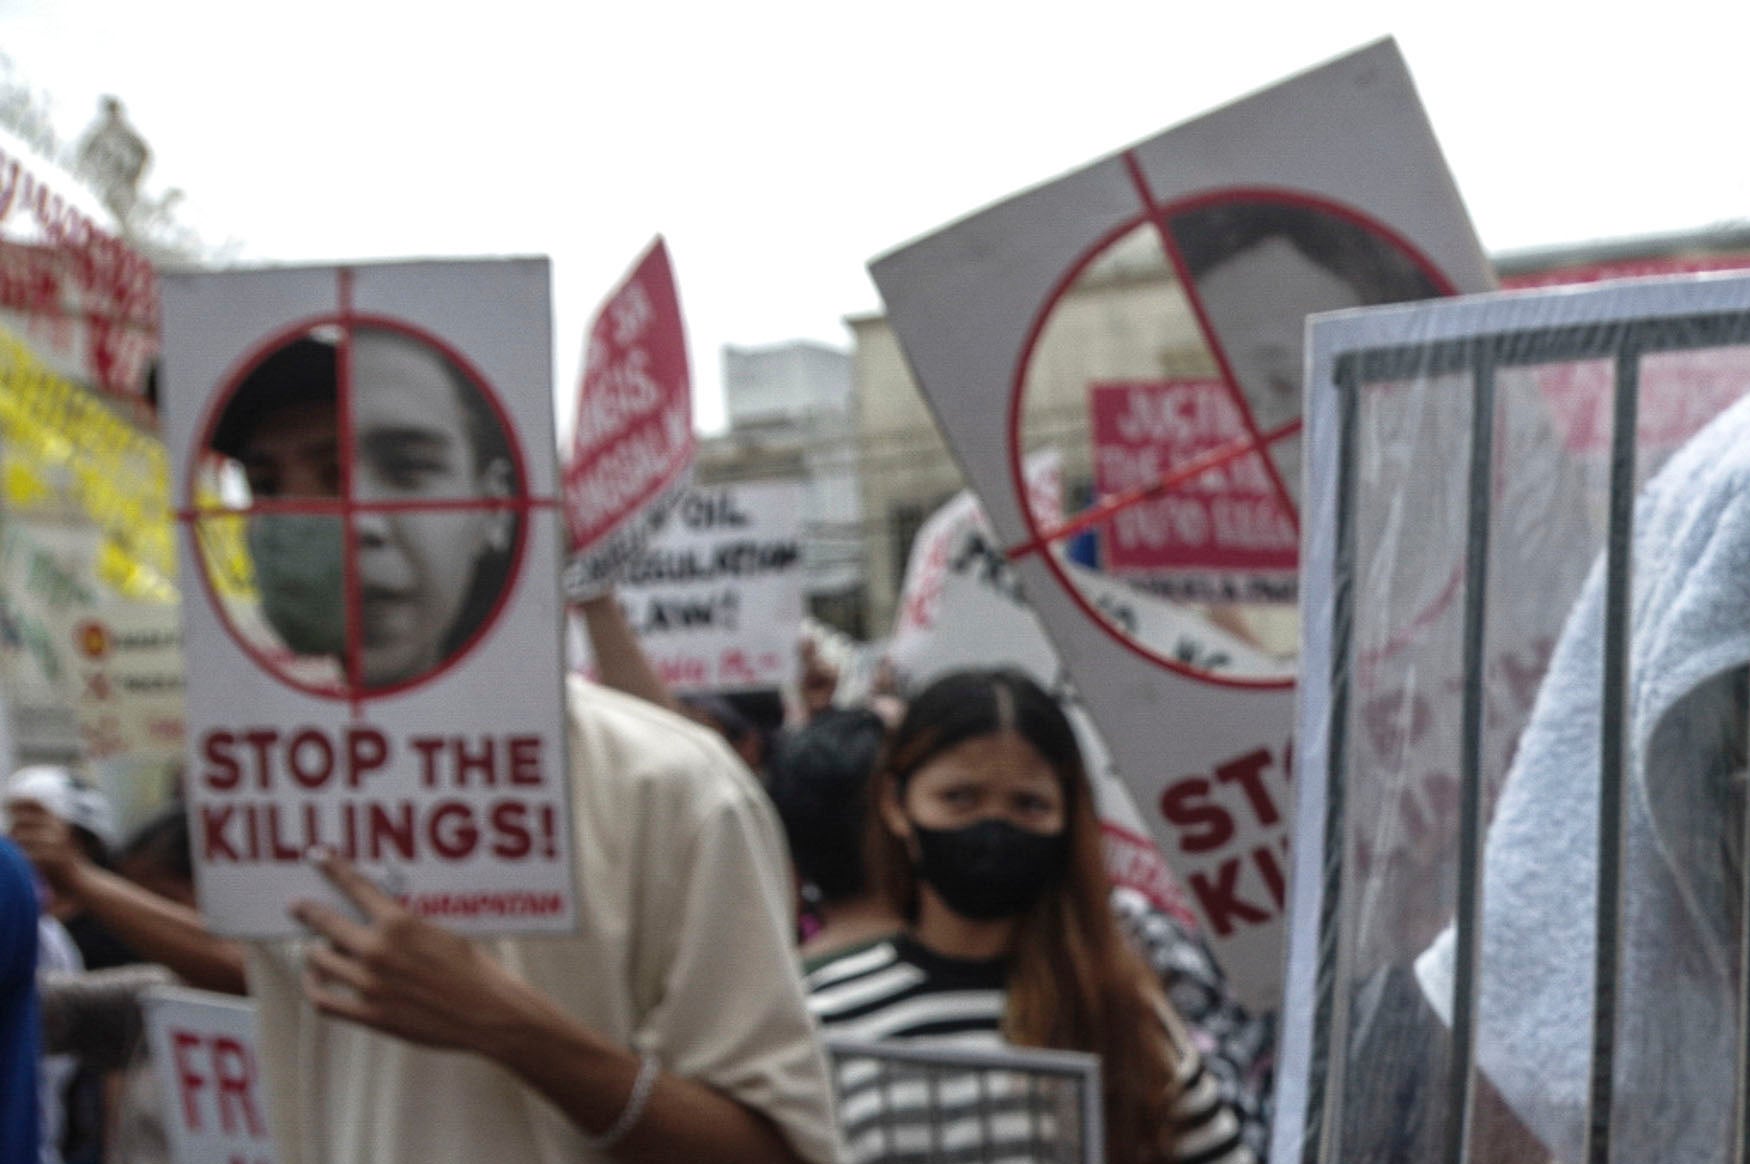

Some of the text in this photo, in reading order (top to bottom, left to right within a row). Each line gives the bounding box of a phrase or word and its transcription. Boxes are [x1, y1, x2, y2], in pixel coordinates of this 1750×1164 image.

[203, 727, 544, 791] STOP THE
[201, 800, 558, 863] KILLINGS!
